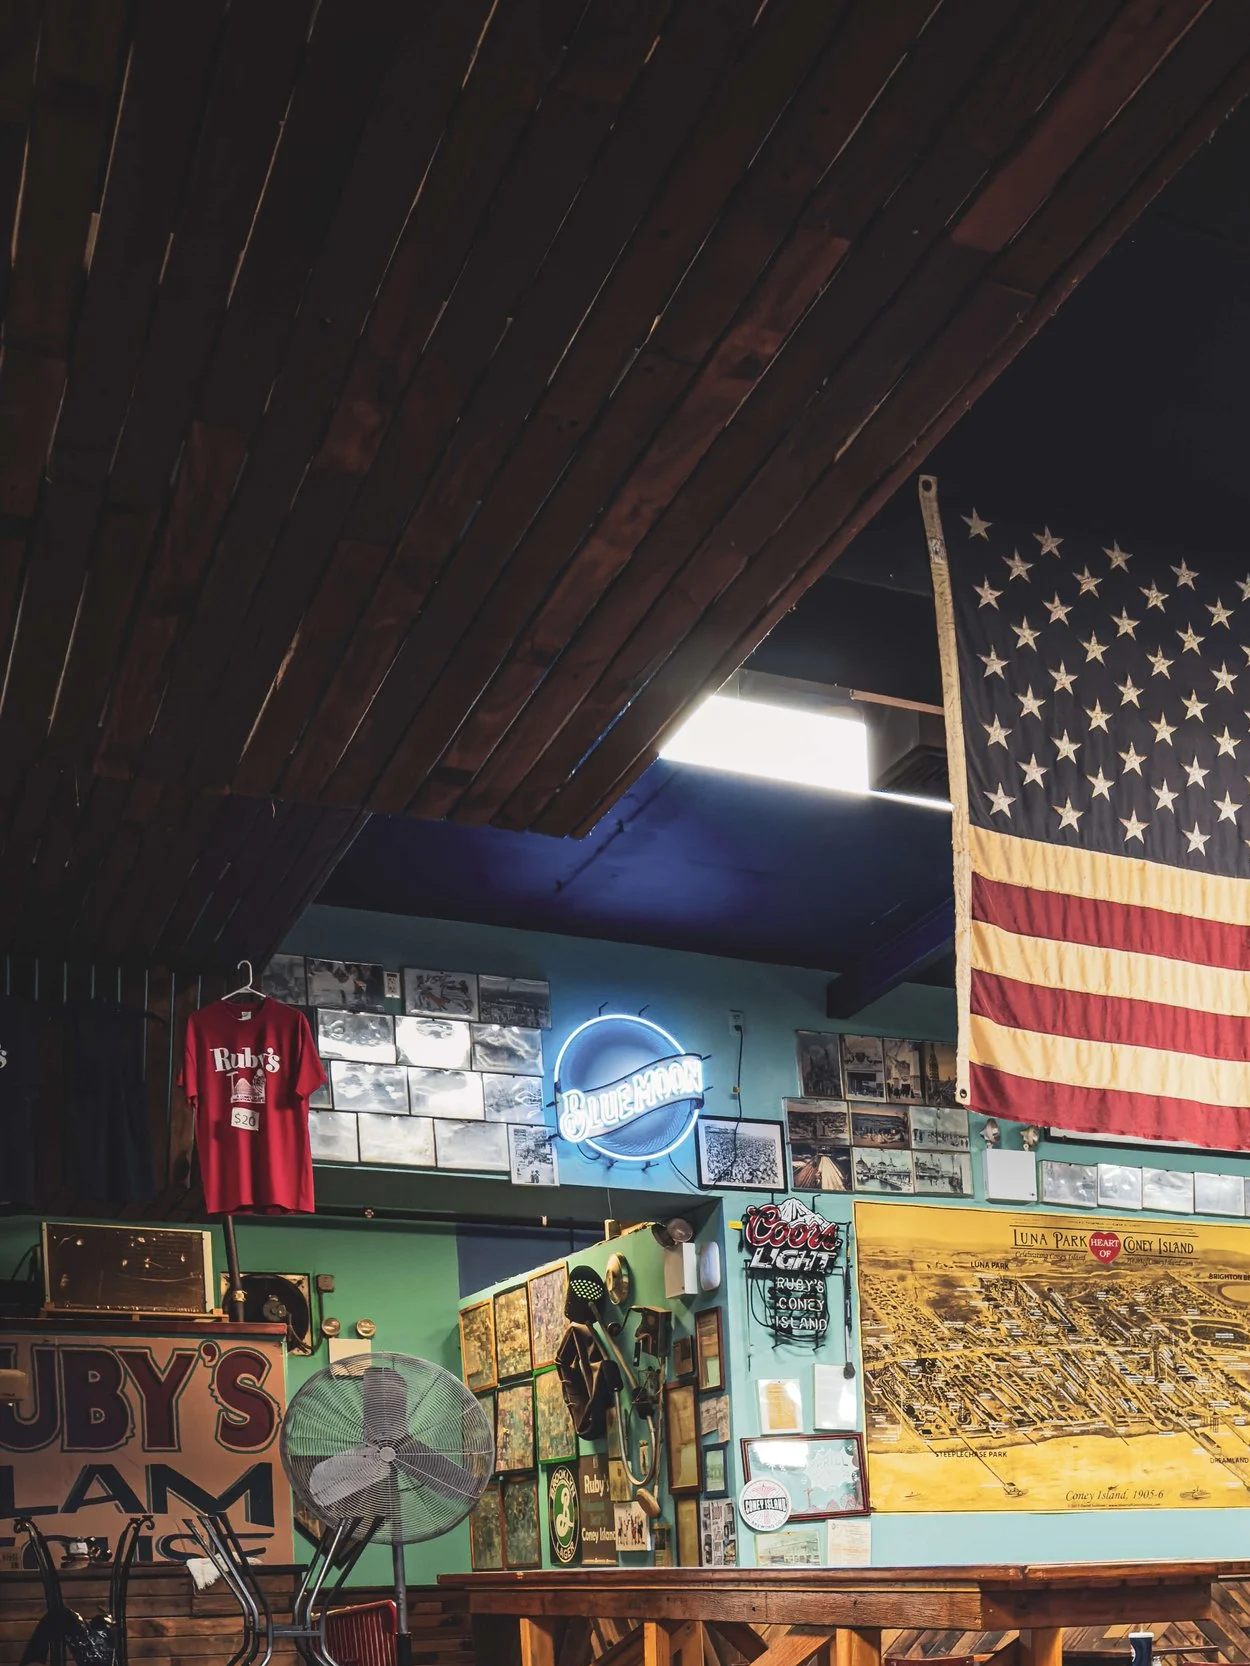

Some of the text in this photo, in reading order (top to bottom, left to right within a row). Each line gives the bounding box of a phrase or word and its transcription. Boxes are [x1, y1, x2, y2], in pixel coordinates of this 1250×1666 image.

[210, 1047, 281, 1073] Ruby's
[559, 1058, 704, 1143] BLUE MOON
[234, 1112, 257, 1127] $20
[746, 1203, 841, 1251] Coors
[1090, 1238, 1120, 1248] HEART
[750, 1247, 837, 1273] LIGHT
[1099, 1249, 1112, 1258] OF
[970, 1261, 1009, 1270] LUNA PARK
[775, 1277, 825, 1293] RUBY'S
[778, 1297, 825, 1312] CONEY
[775, 1315, 828, 1331] ISLAND
[935, 1450, 1008, 1458] STEEPLECHASE PARK
[1065, 1489, 1165, 1504] Coney Island, 1905-6
[745, 1497, 787, 1514] CONEY ISLAND
[581, 1528, 599, 1544] Coney
[555, 1541, 575, 1560] LAGER
